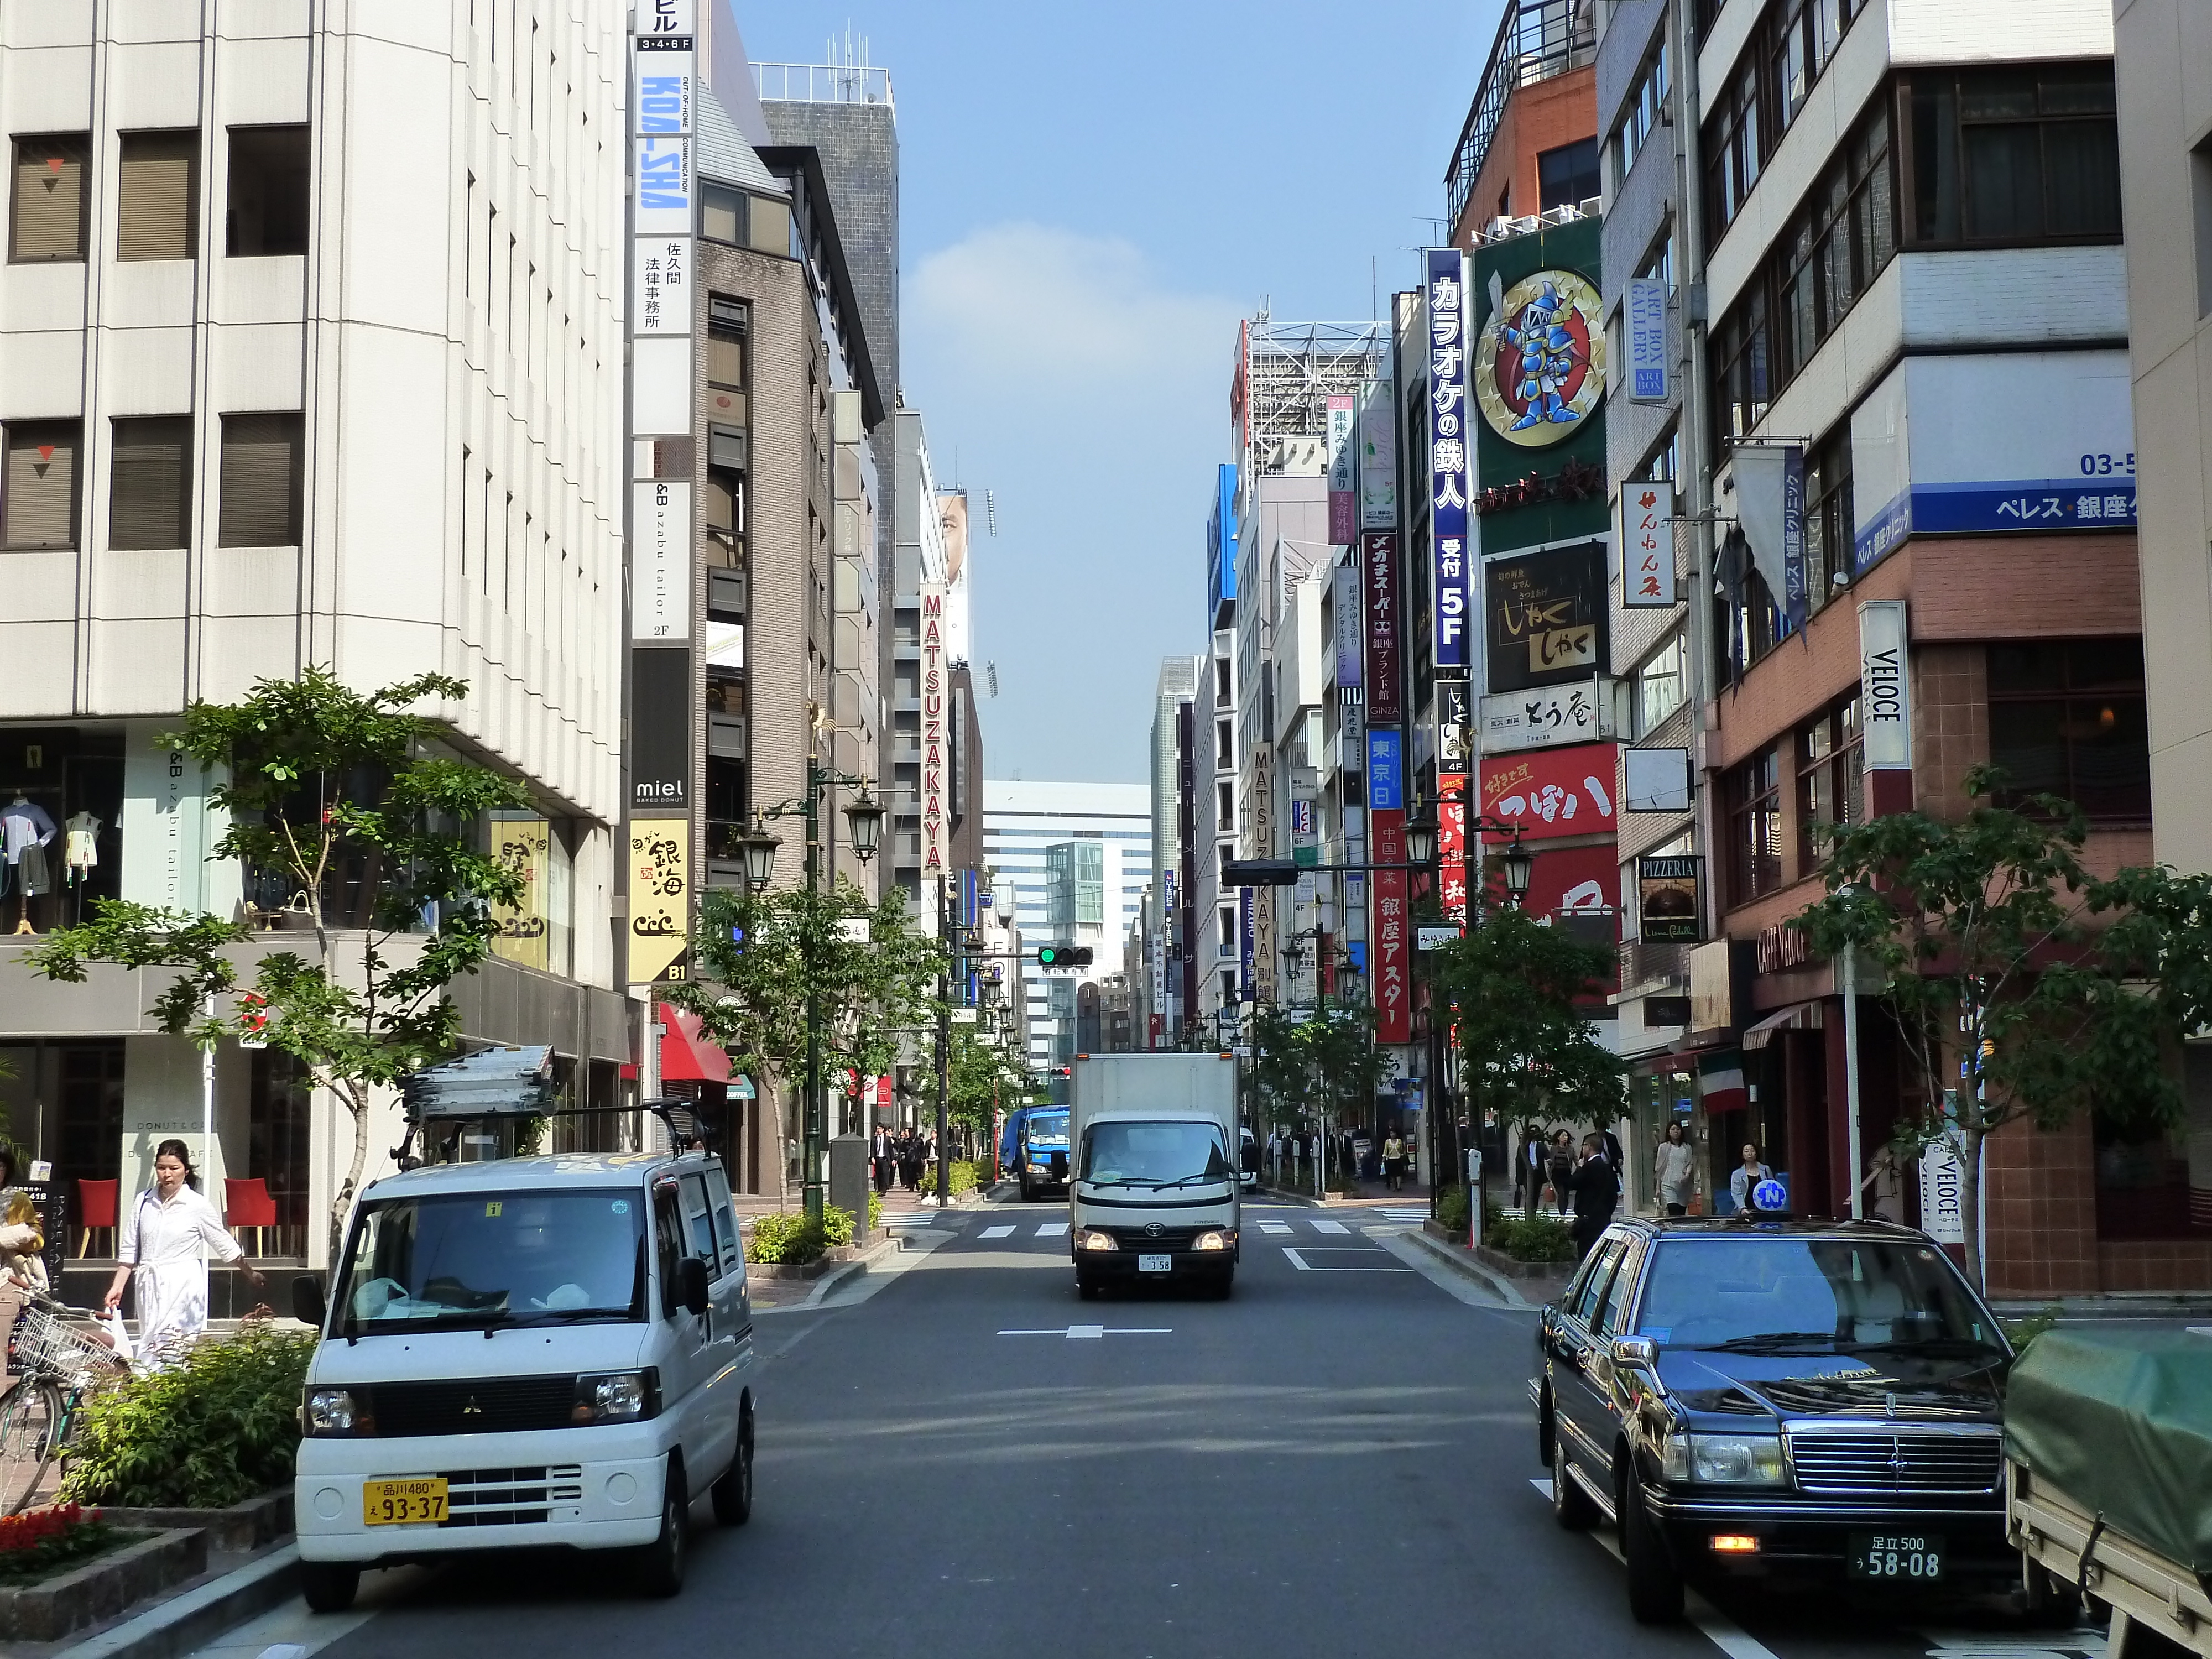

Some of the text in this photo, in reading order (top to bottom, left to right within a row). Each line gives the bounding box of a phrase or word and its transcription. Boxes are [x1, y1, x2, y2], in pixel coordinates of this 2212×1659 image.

[666, 242, 681, 285] 佐久間
[645, 257, 660, 328] 法律事務所
[1631, 284, 1647, 366] GALLERY
[1647, 284, 1663, 364] ART BOX
[1431, 276, 1465, 509] カラオケの鉄人
[1637, 372, 1661, 380] ART
[1637, 381, 1661, 390] BOX
[1333, 398, 1348, 409] 2F
[1334, 410, 1348, 541] 銀座みゆき通り 美容外科
[656, 483, 669, 616] &B azabu tailor
[1441, 538, 1462, 578] 受付
[1371, 536, 1391, 619] メガネスーパー
[1512, 581, 1531, 592] おでん
[654, 625, 669, 636] 2F
[1338, 603, 1346, 672] デンタルクリニック
[1348, 584, 1358, 647] 銀座みゆき通り
[1441, 587, 1464, 645] 5F
[1372, 638, 1394, 649] 銀座
[1378, 650, 1390, 701] ブランド館
[1862, 650, 1871, 724] VELOCE
[1871, 648, 1901, 722] VELOCE
[923, 593, 942, 868] MATSUZAKAYA
[1370, 706, 1399, 714] GINZA
[636, 780, 684, 797] miel
[1448, 763, 1463, 771] 4F
[1498, 776, 1613, 823] つぼ八
[648, 839, 686, 897] 銀海
[1254, 750, 1270, 959] MATSUZKAYA
[1642, 860, 1693, 877] PIZZERIA
[668, 966, 685, 980] B1
[1257, 967, 1271, 998] 別館
[1380, 896, 1401, 1025] 銀座アスター
[1765, 1190, 1780, 1203] N
[1937, 1160, 1959, 1215] VELOCE
[370, 1496, 444, 1521] え 93-37
[1856, 1551, 1939, 1577] う 58-08
[1872, 1536, 1924, 1550] 足立 500
